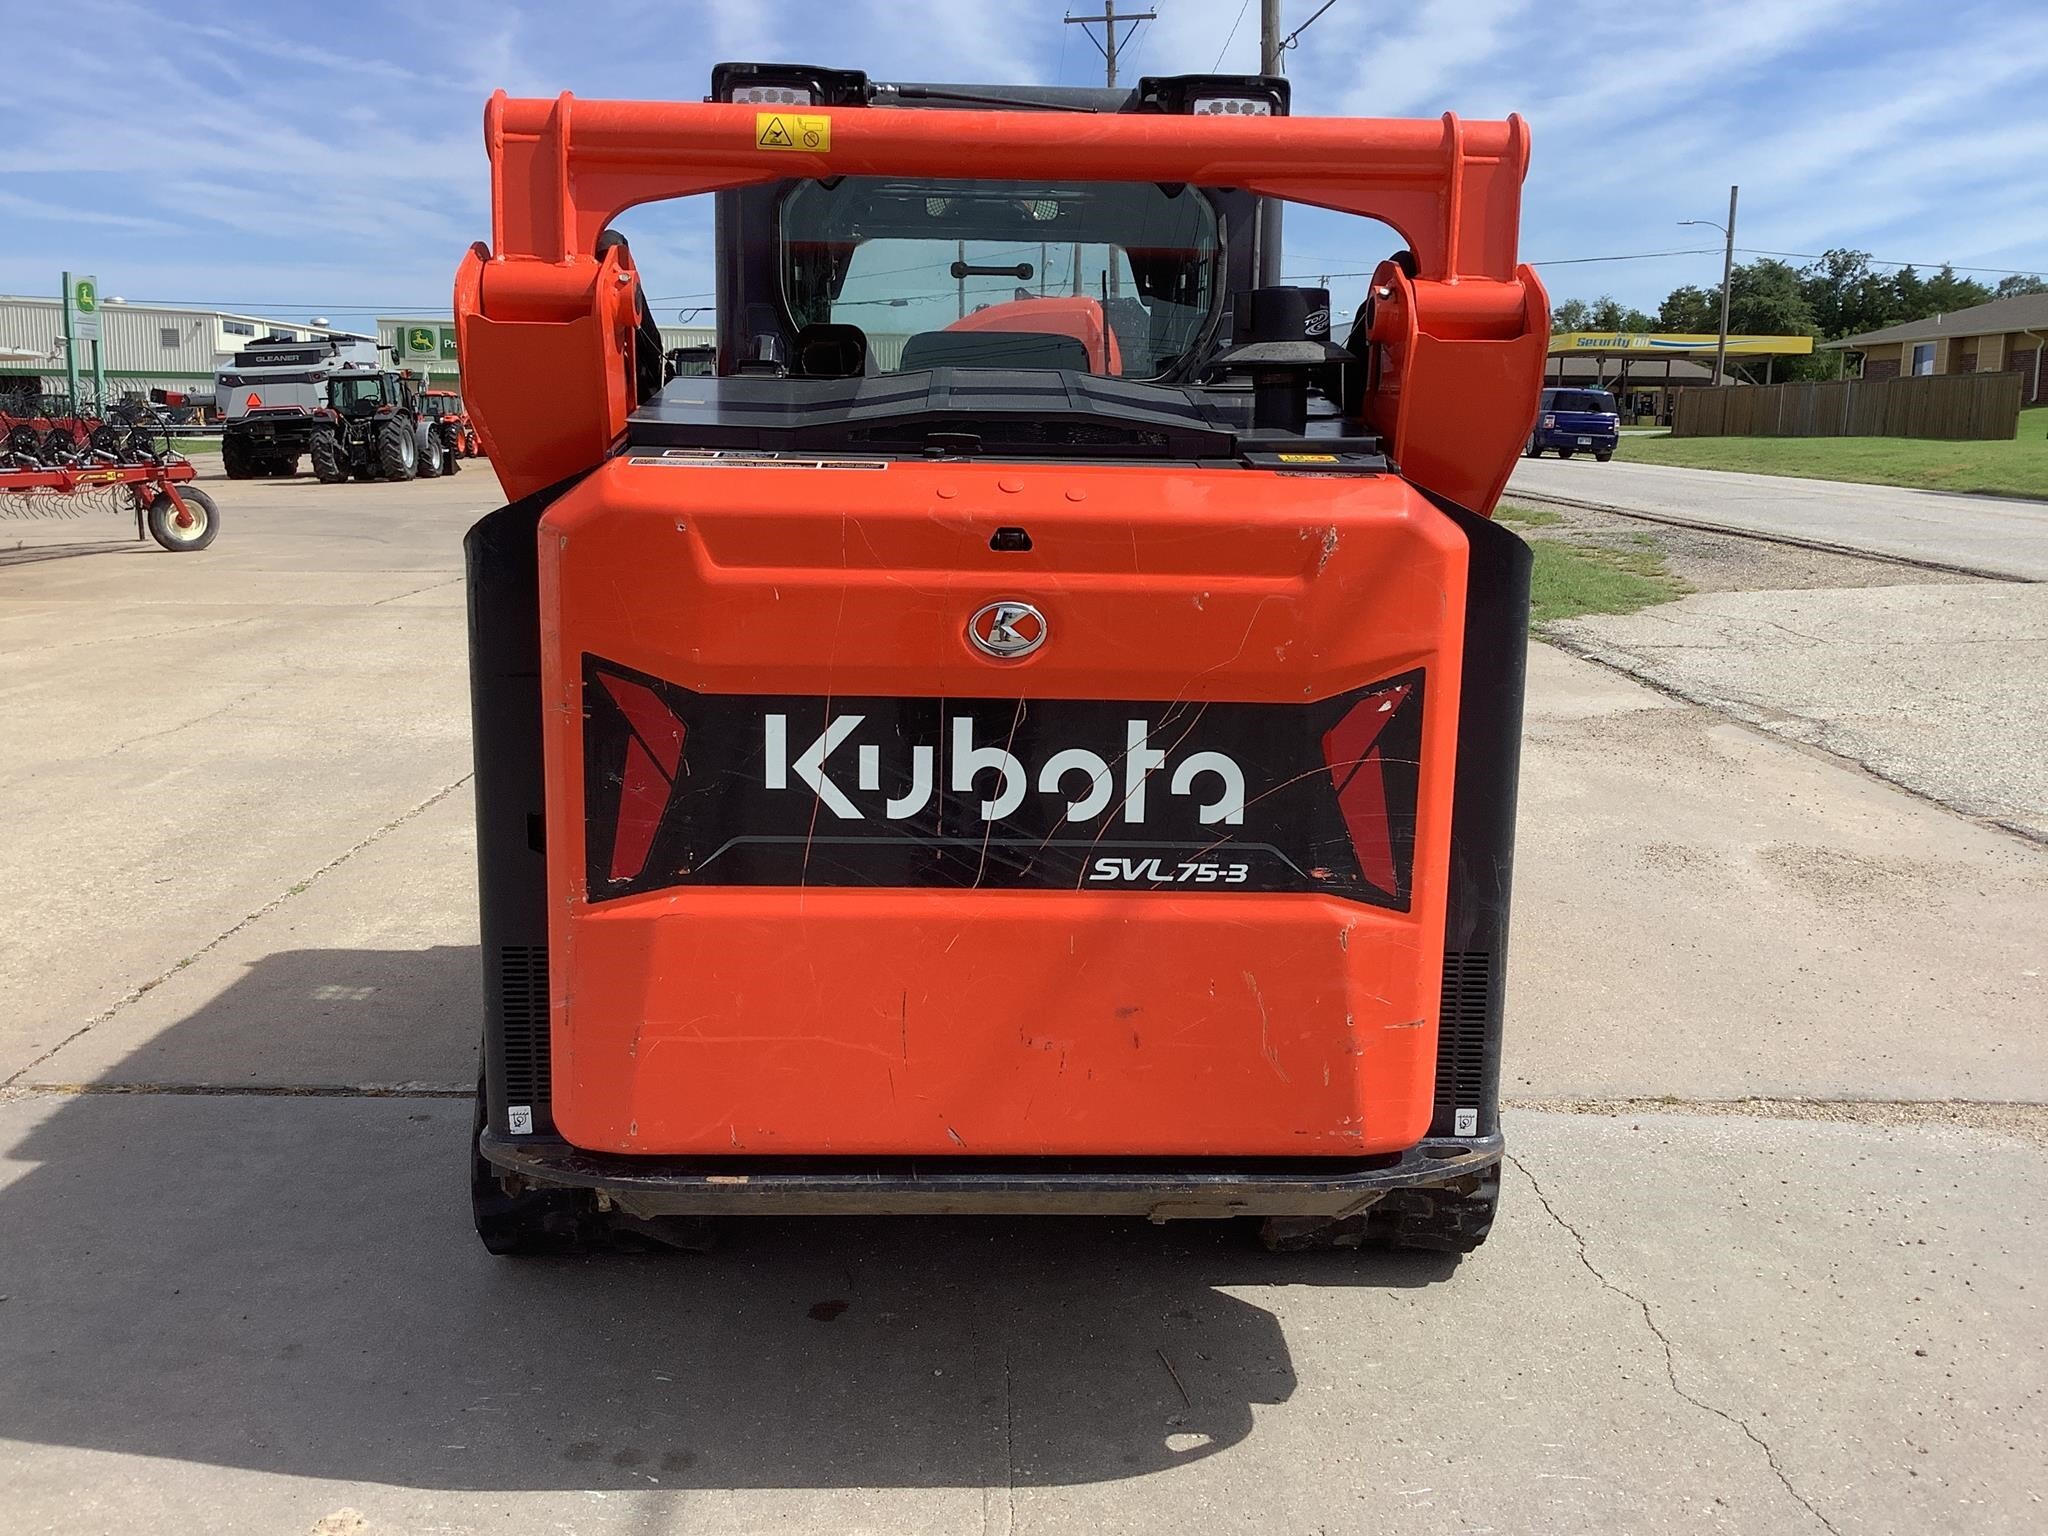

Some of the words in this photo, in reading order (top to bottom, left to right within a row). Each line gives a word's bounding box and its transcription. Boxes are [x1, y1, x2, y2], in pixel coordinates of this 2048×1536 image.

[1577, 337, 1630, 348] Security
[255, 354, 300, 363] GLEANER
[765, 714, 1245, 825] Kubota
